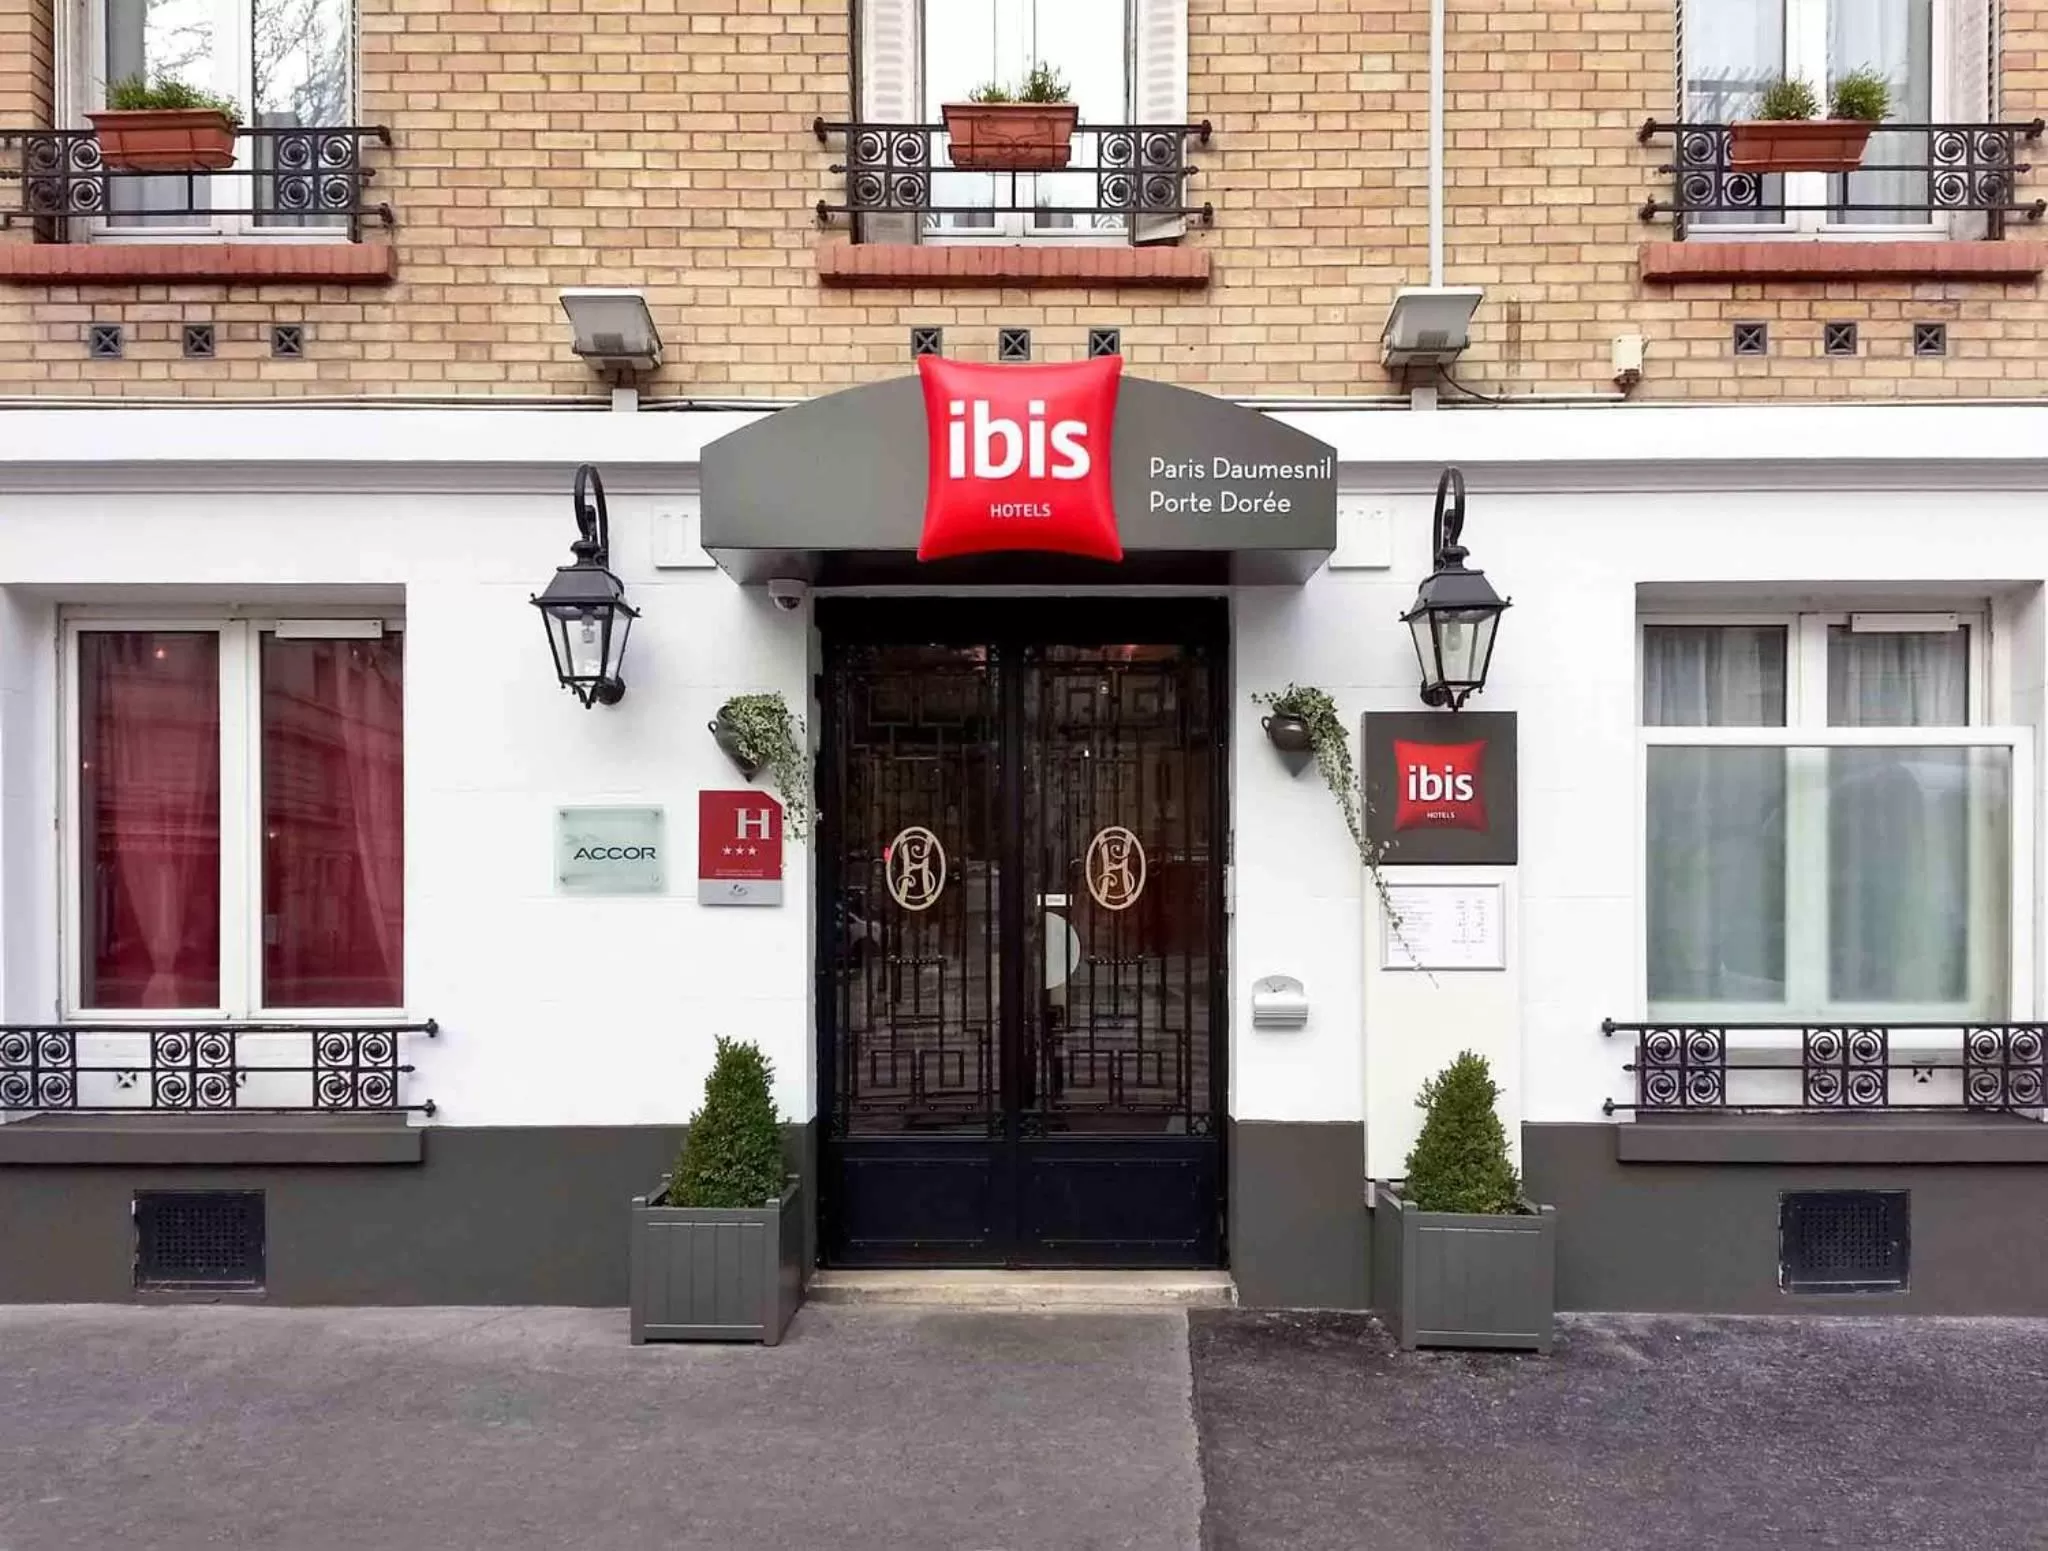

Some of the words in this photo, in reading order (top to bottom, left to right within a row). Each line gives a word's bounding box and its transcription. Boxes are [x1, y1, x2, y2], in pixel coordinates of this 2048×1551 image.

[948, 400, 1091, 480] ibis
[1149, 456, 1205, 480] Paris
[1212, 456, 1332, 480] Daumesnil
[990, 503, 1052, 518] HOTELS
[1149, 491, 1213, 514] Porte
[1219, 491, 1292, 514] Dorée
[1407, 764, 1474, 801] ibis
[735, 807, 773, 840] H
[1426, 811, 1456, 819] HOTELS
[573, 847, 657, 861] ACCOR
